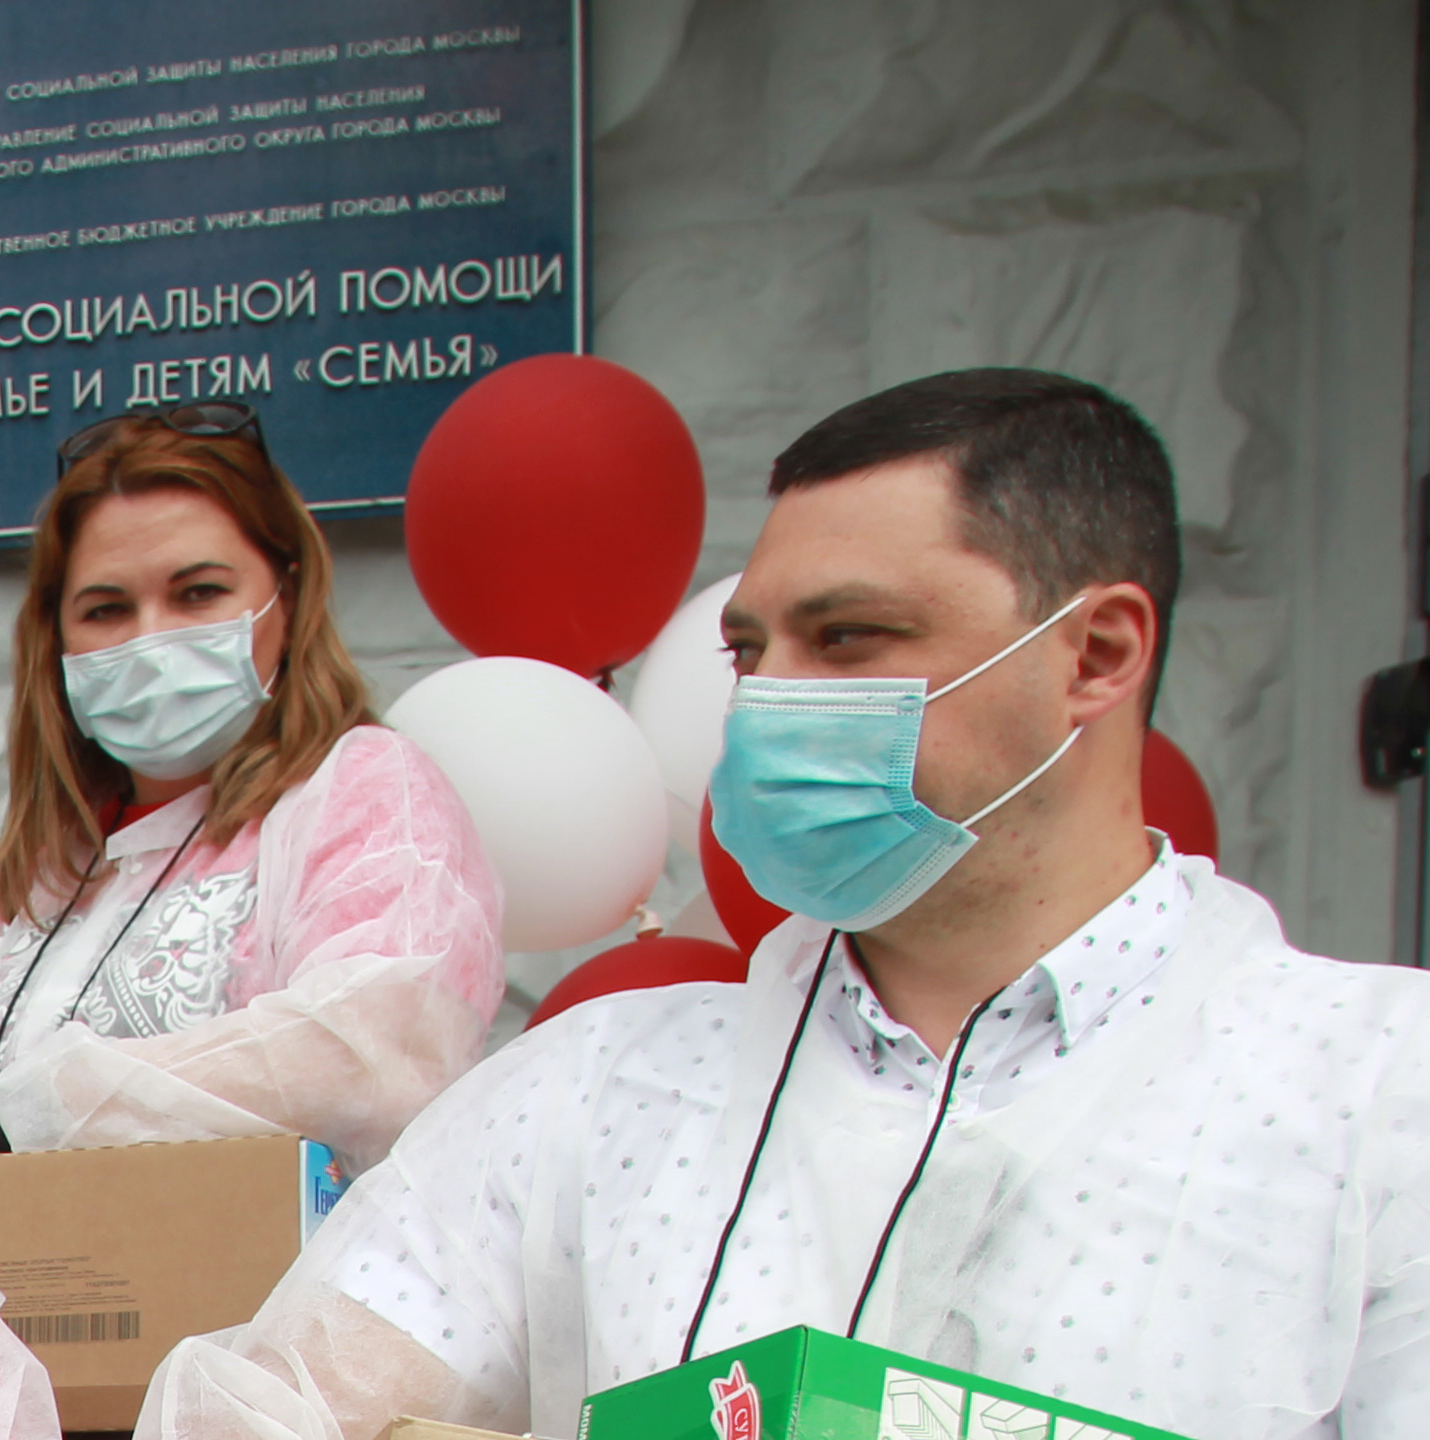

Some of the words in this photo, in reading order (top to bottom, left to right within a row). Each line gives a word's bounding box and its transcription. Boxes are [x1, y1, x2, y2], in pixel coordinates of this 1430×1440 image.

[6, 66, 138, 101] СОЦИАЛЬНОЙ
[146, 59, 222, 83] ЗАЩИТЫ
[229, 44, 338, 73] НАСЕЛЕНИЯ
[345, 35, 426, 59] ГОРОДА
[432, 25, 521, 50] МОСКВЫ
[41, 133, 246, 175] АДМИНИСТРАТИВНОГО
[253, 124, 327, 149] ОКРУГА
[331, 116, 410, 140] ГОРОДА
[415, 106, 502, 133] МОСКВЫ
[85, 104, 220, 139] СОЦИАЛЬНОЙ
[229, 98, 308, 123] ЗАЩИТЫ
[316, 84, 426, 112] НАСЕЛЕНИЯ
[77, 215, 197, 246] БЮДЖЕТНОЕ
[204, 202, 325, 231] УЧРЕЖДЕНИЕ
[330, 194, 411, 218] ГОРОДА
[417, 185, 507, 211] МОСКВЫ
[339, 253, 563, 313] ПОМОЩИ
[72, 368, 103, 411] И
[124, 352, 273, 410] ДЕТЯМ
[292, 333, 500, 388] «СЕМЬЯ»
